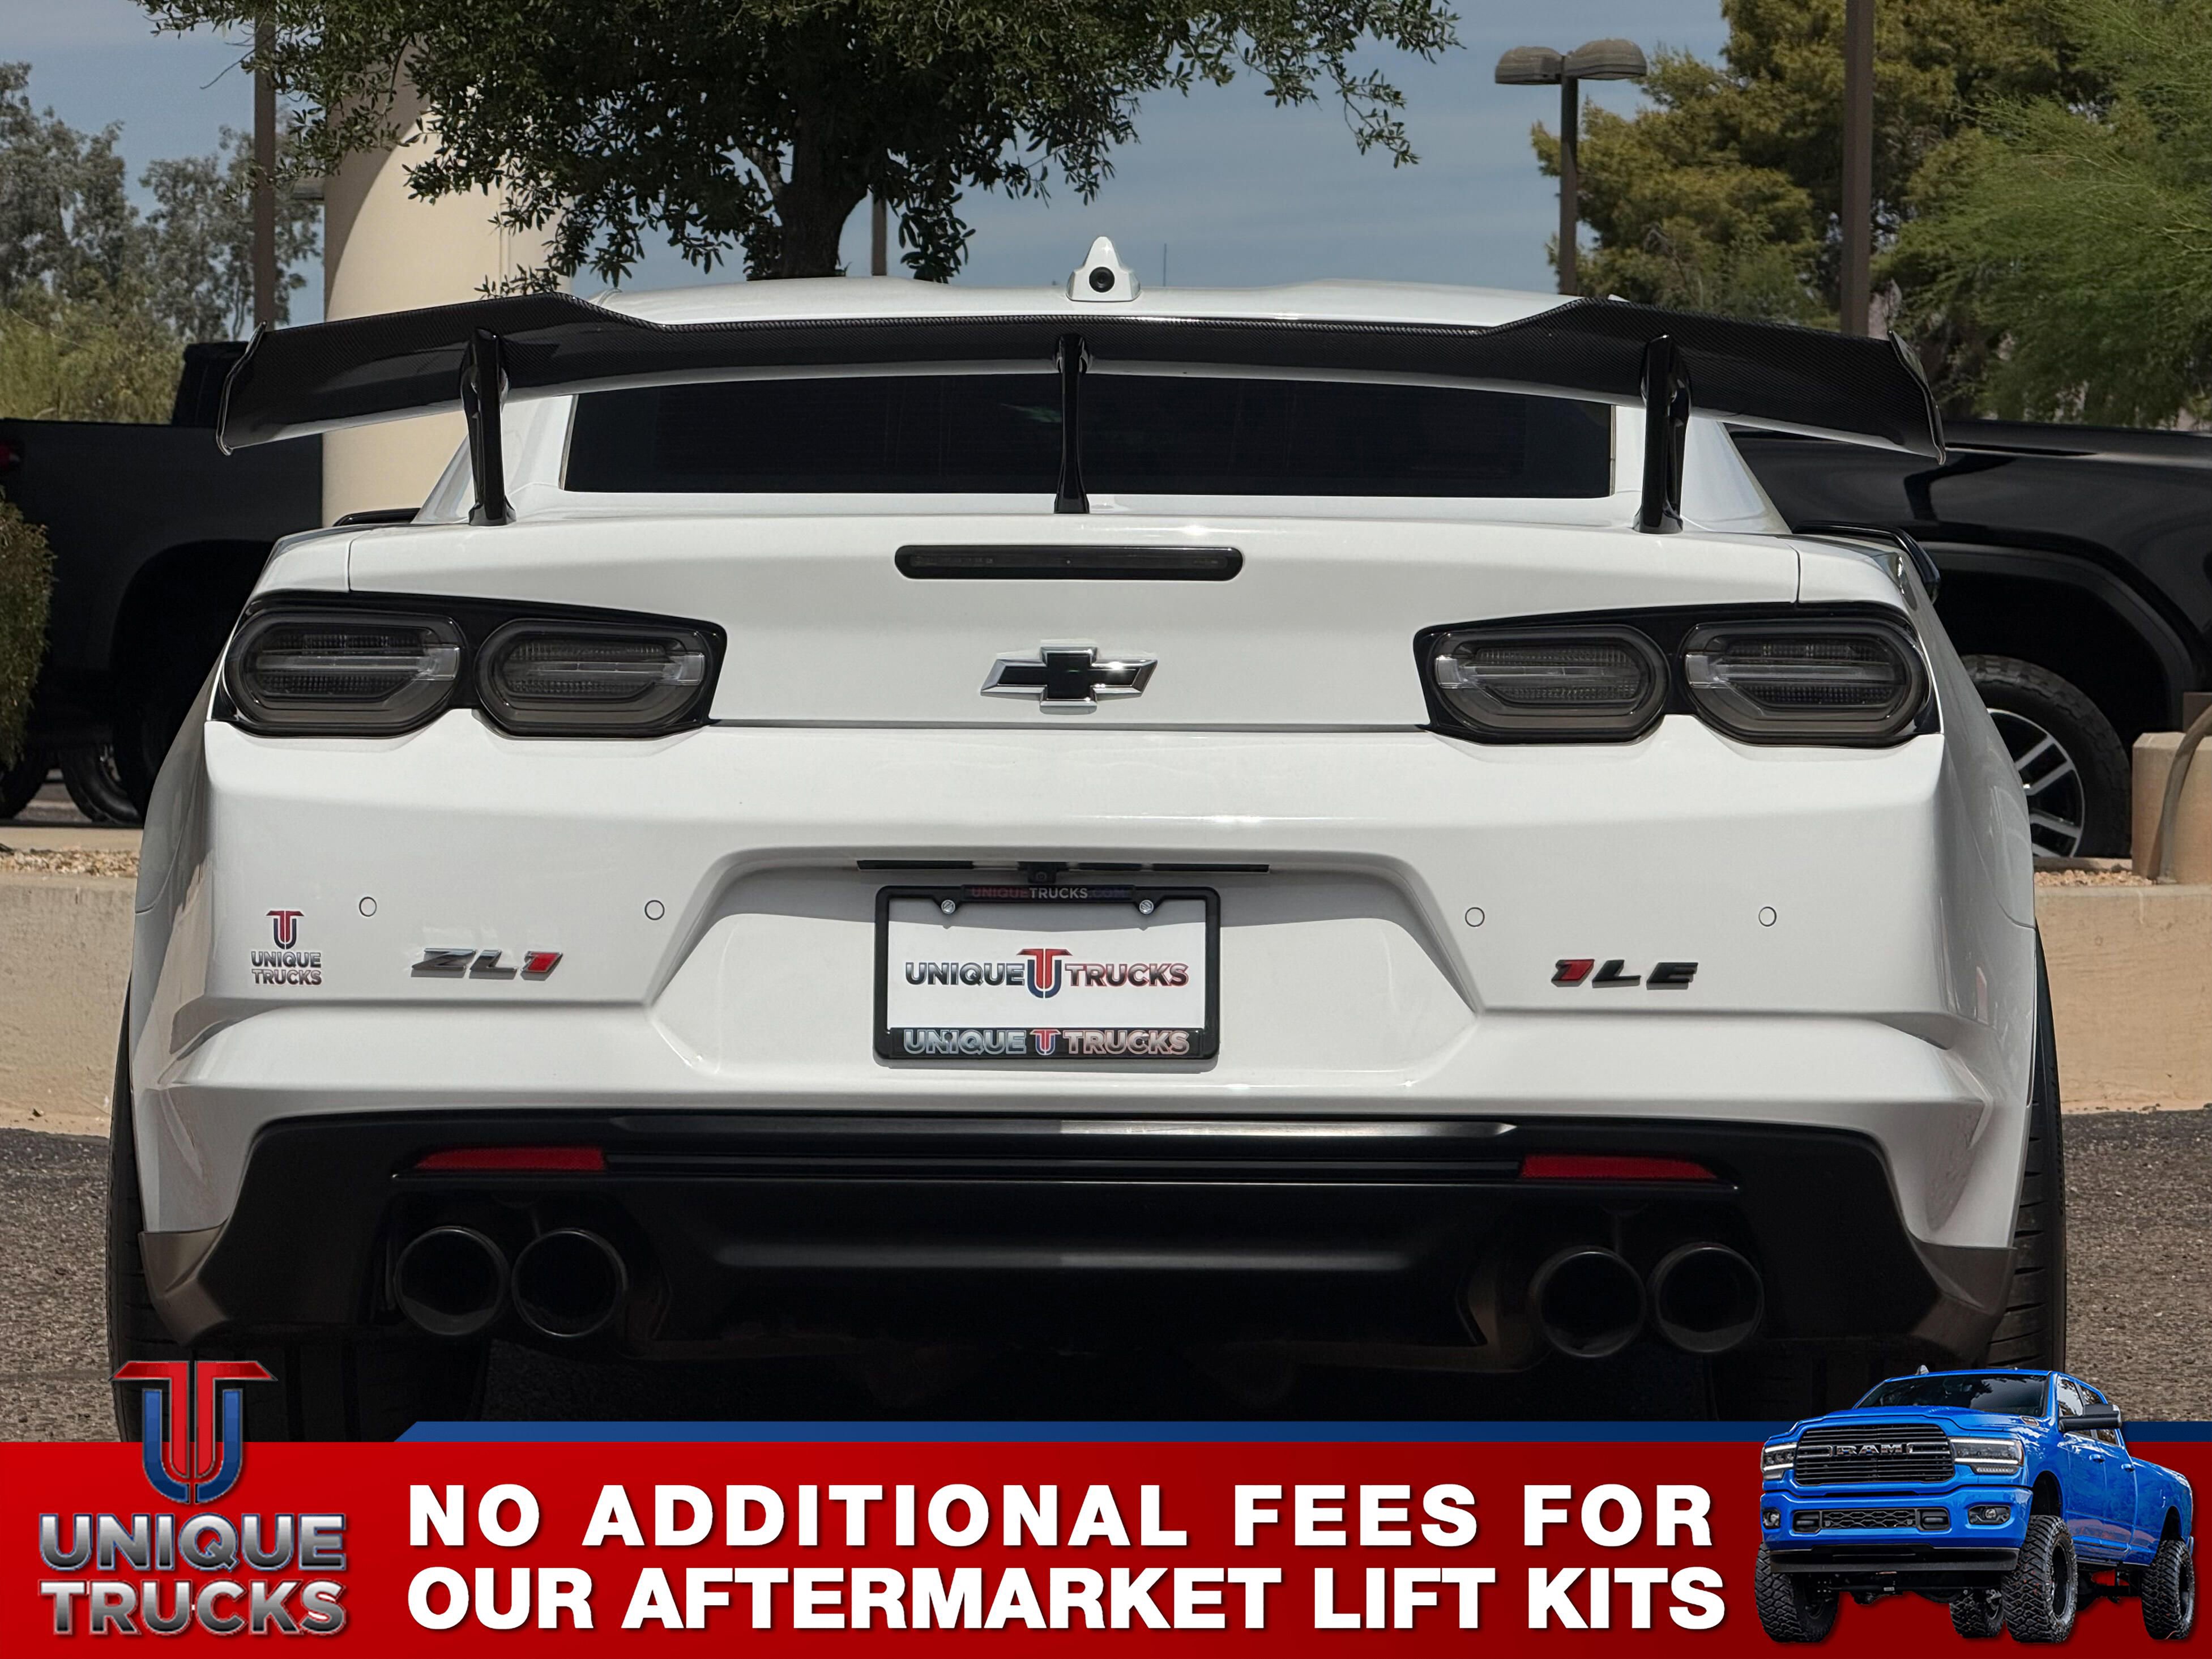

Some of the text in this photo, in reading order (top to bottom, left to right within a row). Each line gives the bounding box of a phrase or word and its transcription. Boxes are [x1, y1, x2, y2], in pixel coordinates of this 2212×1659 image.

[251, 951, 322, 967] UNIQUE
[411, 948, 563, 980] ZL1
[252, 969, 322, 986] TRUCKS
[906, 962, 1024, 986] UNIQUE
[1065, 963, 1188, 987] TRUCKS
[904, 1030, 1026, 1055] UNIQUE
[1063, 1030, 1190, 1055] TRUCKS
